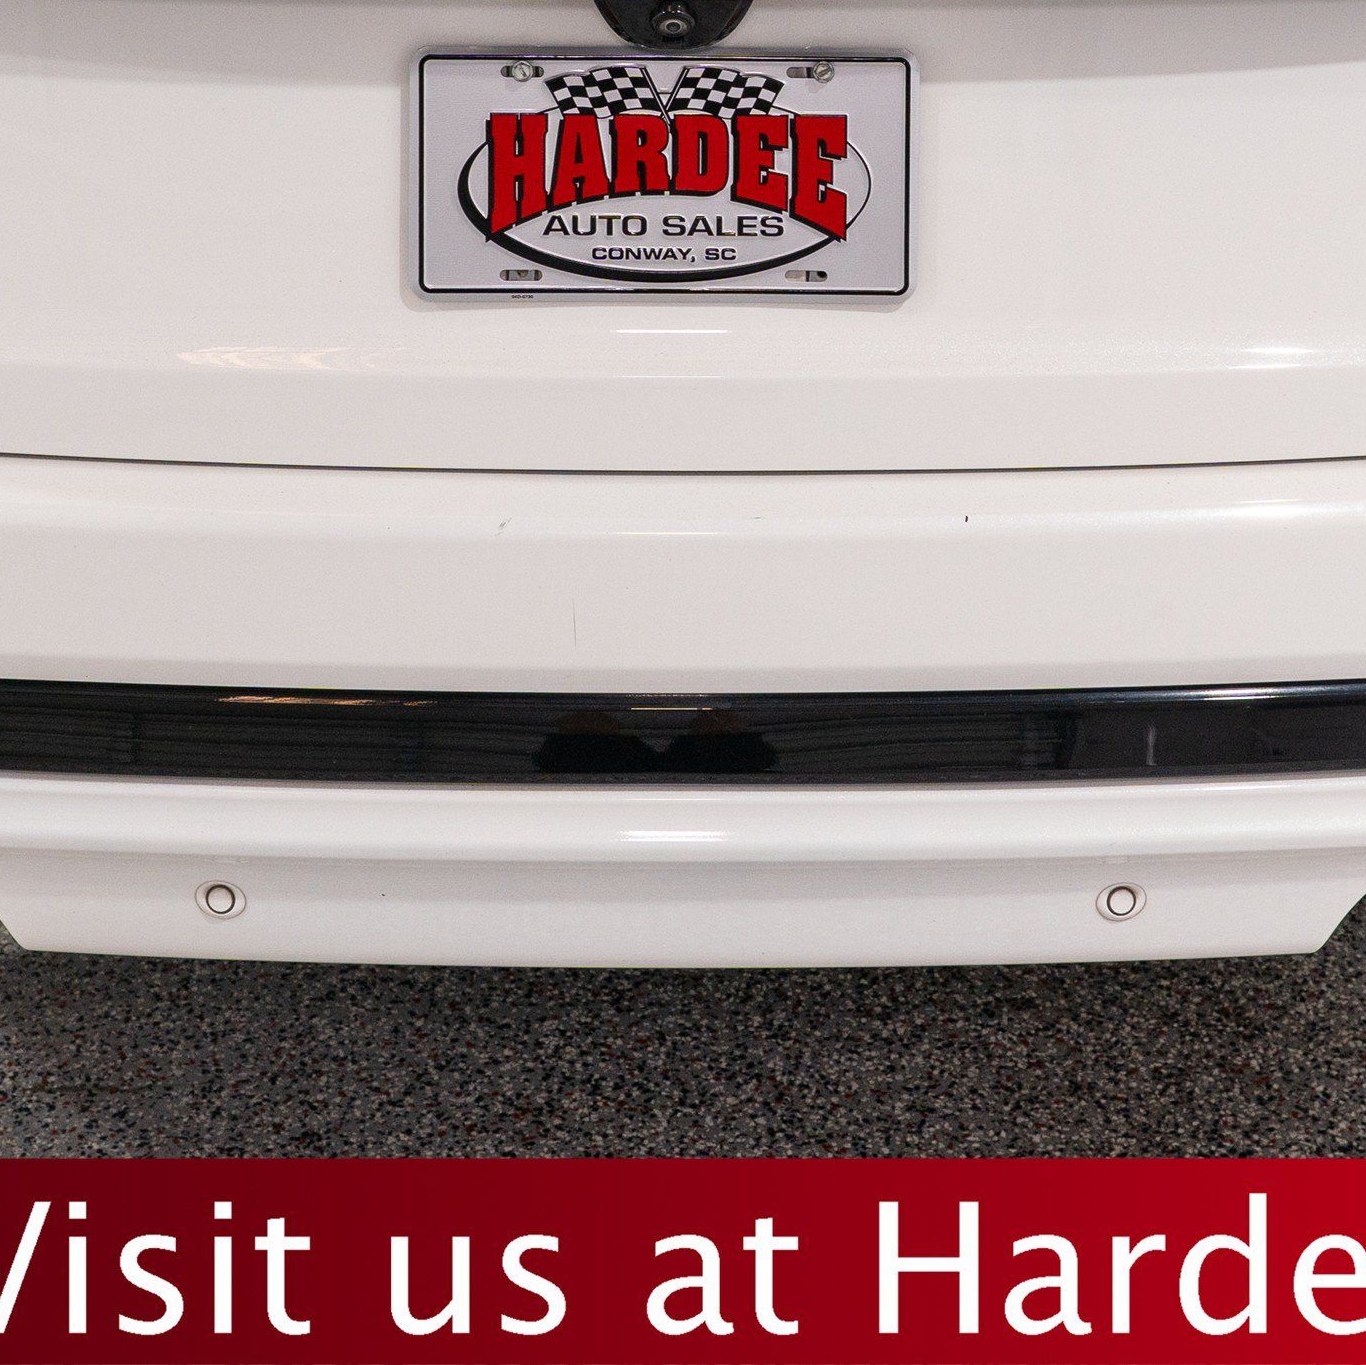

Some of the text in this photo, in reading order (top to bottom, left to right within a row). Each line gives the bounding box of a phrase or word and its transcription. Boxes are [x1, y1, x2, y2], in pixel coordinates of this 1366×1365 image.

[486, 111, 848, 242] HARDEE
[542, 214, 785, 237] AUTO SALES
[591, 246, 737, 265] CONWAY, SC
